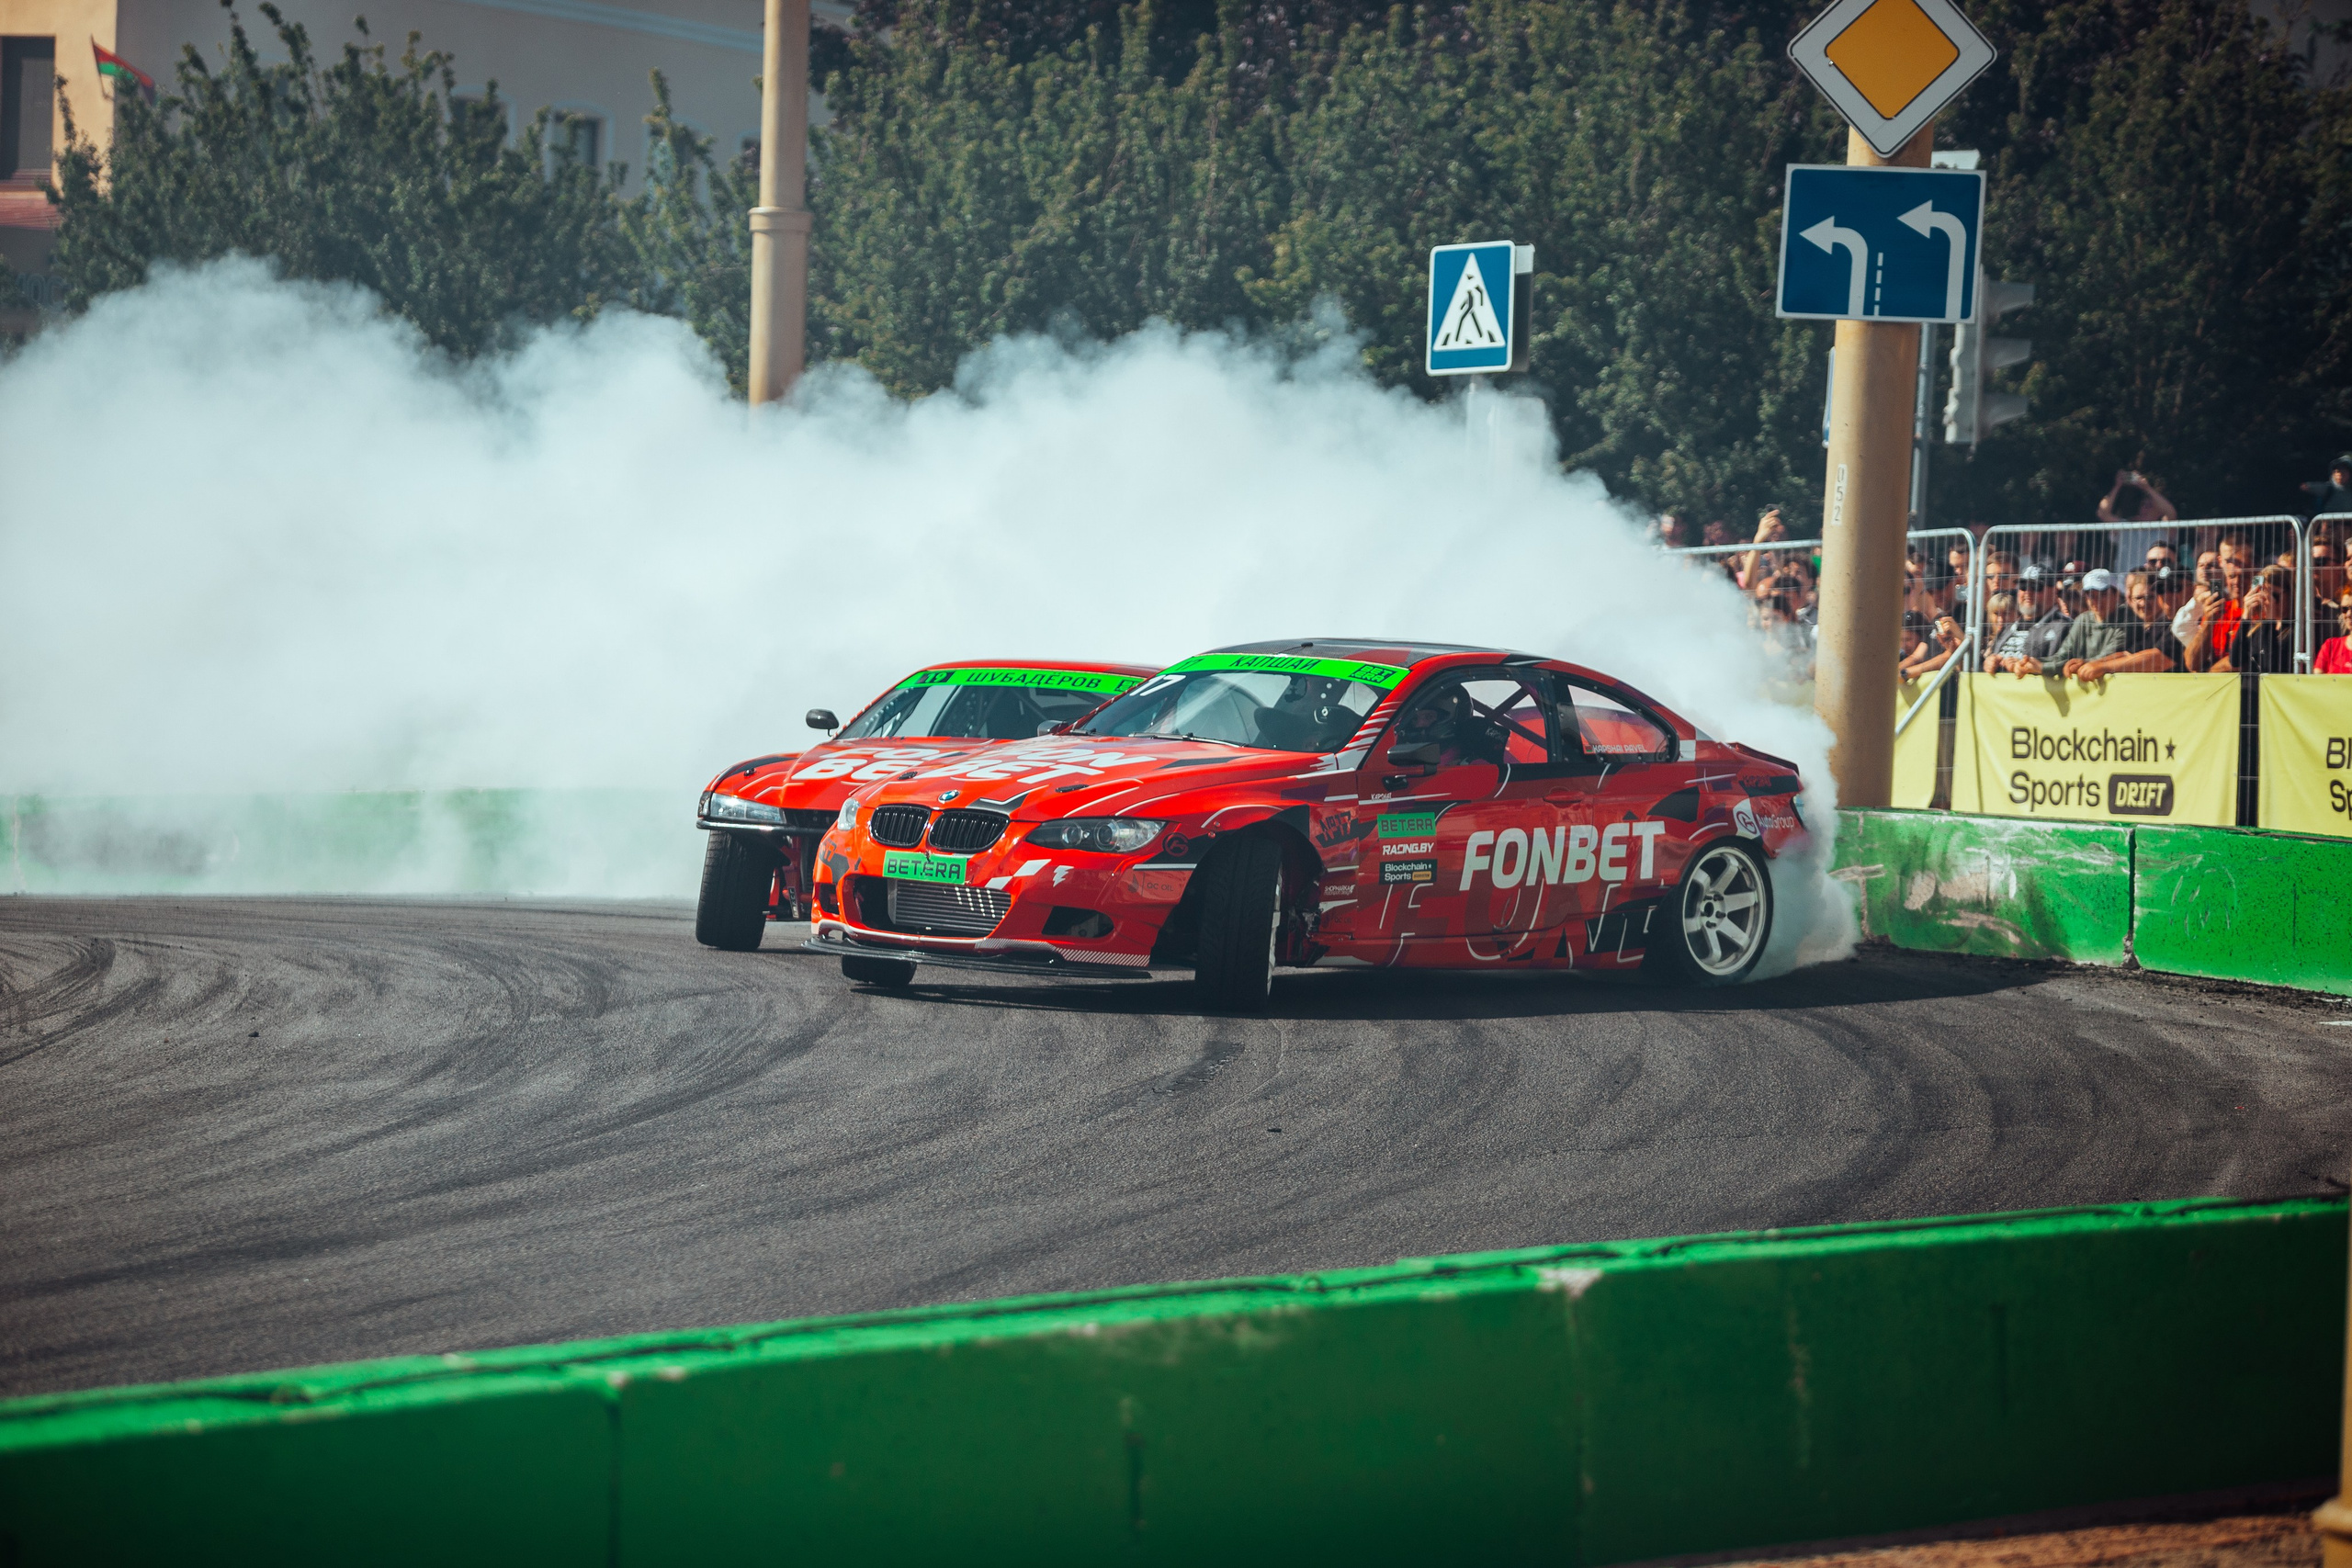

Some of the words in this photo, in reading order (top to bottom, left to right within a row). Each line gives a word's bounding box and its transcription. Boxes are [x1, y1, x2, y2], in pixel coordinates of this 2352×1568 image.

[926, 671, 948, 683] 19
[966, 671, 1102, 689] ШУБАДЁРОВ
[1129, 674, 1186, 696] 17
[2012, 726, 2159, 761] Blockchain
[914, 759, 1105, 784] BET
[2008, 770, 2101, 812] Sports
[2114, 781, 2167, 808] DRIFT
[1459, 820, 1666, 891] FONBET
[1385, 862, 1428, 872] Blockchain
[1385, 872, 1412, 882] Sports
